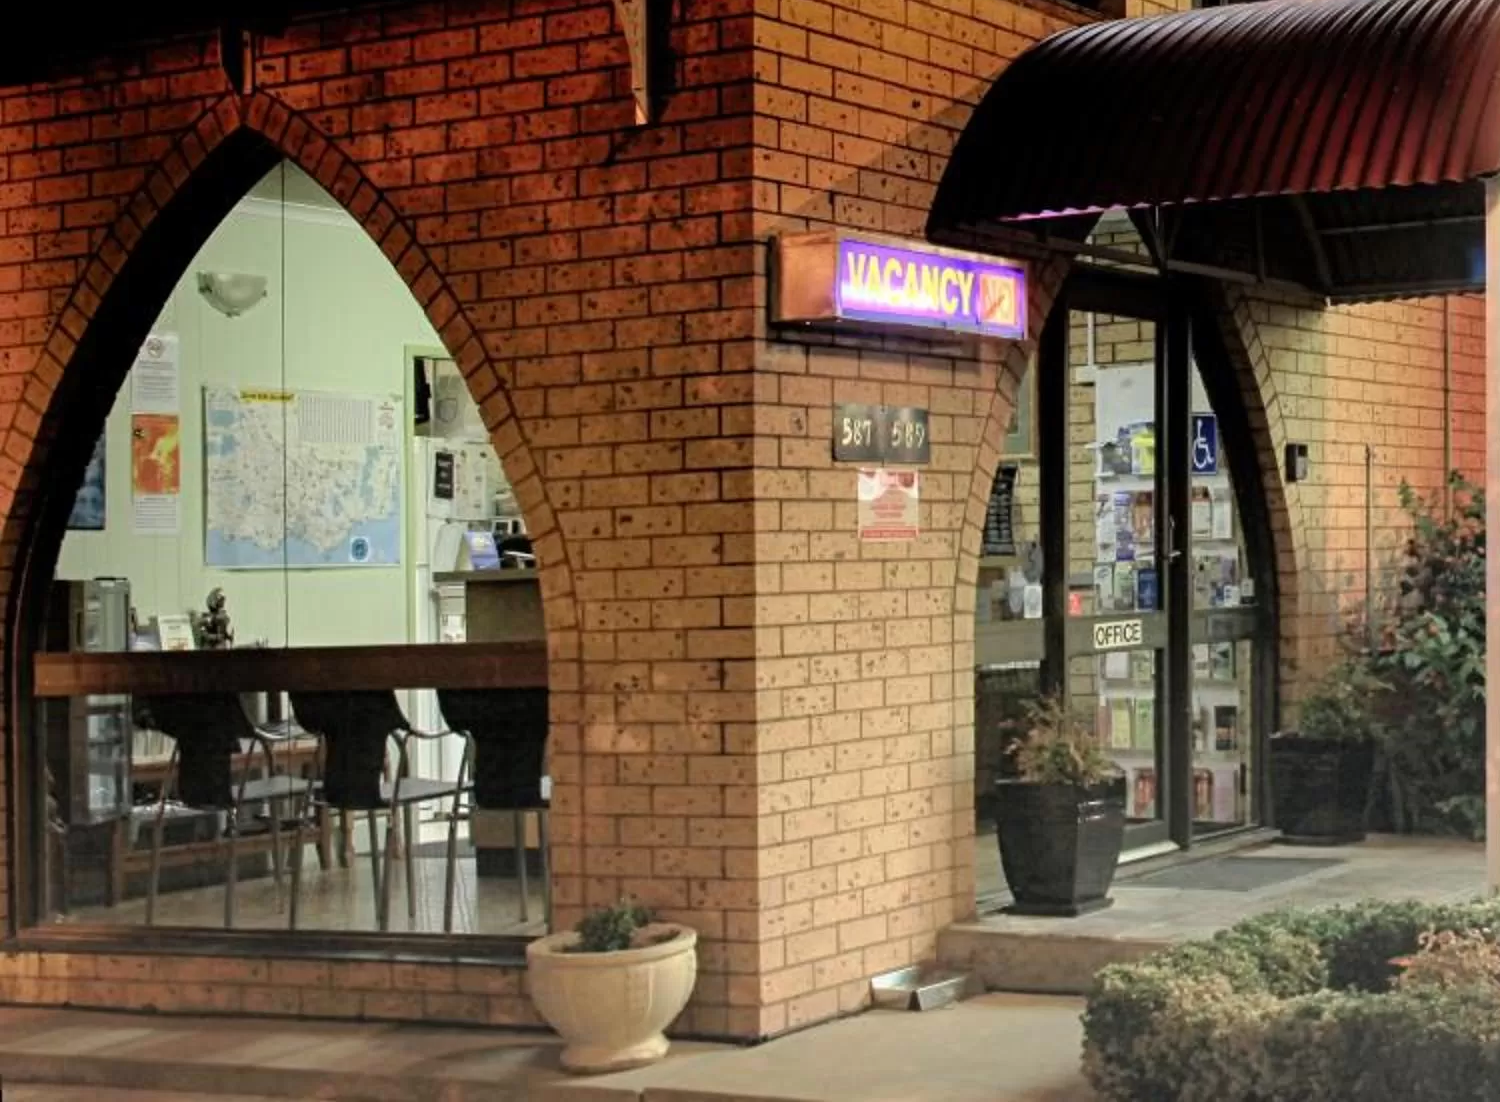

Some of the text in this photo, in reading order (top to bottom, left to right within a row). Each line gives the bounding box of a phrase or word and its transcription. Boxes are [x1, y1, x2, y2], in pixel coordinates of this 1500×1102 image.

[846, 251, 975, 316] VACANCY
[841, 417, 873, 447] 587
[1095, 623, 1142, 645] OFFICE
